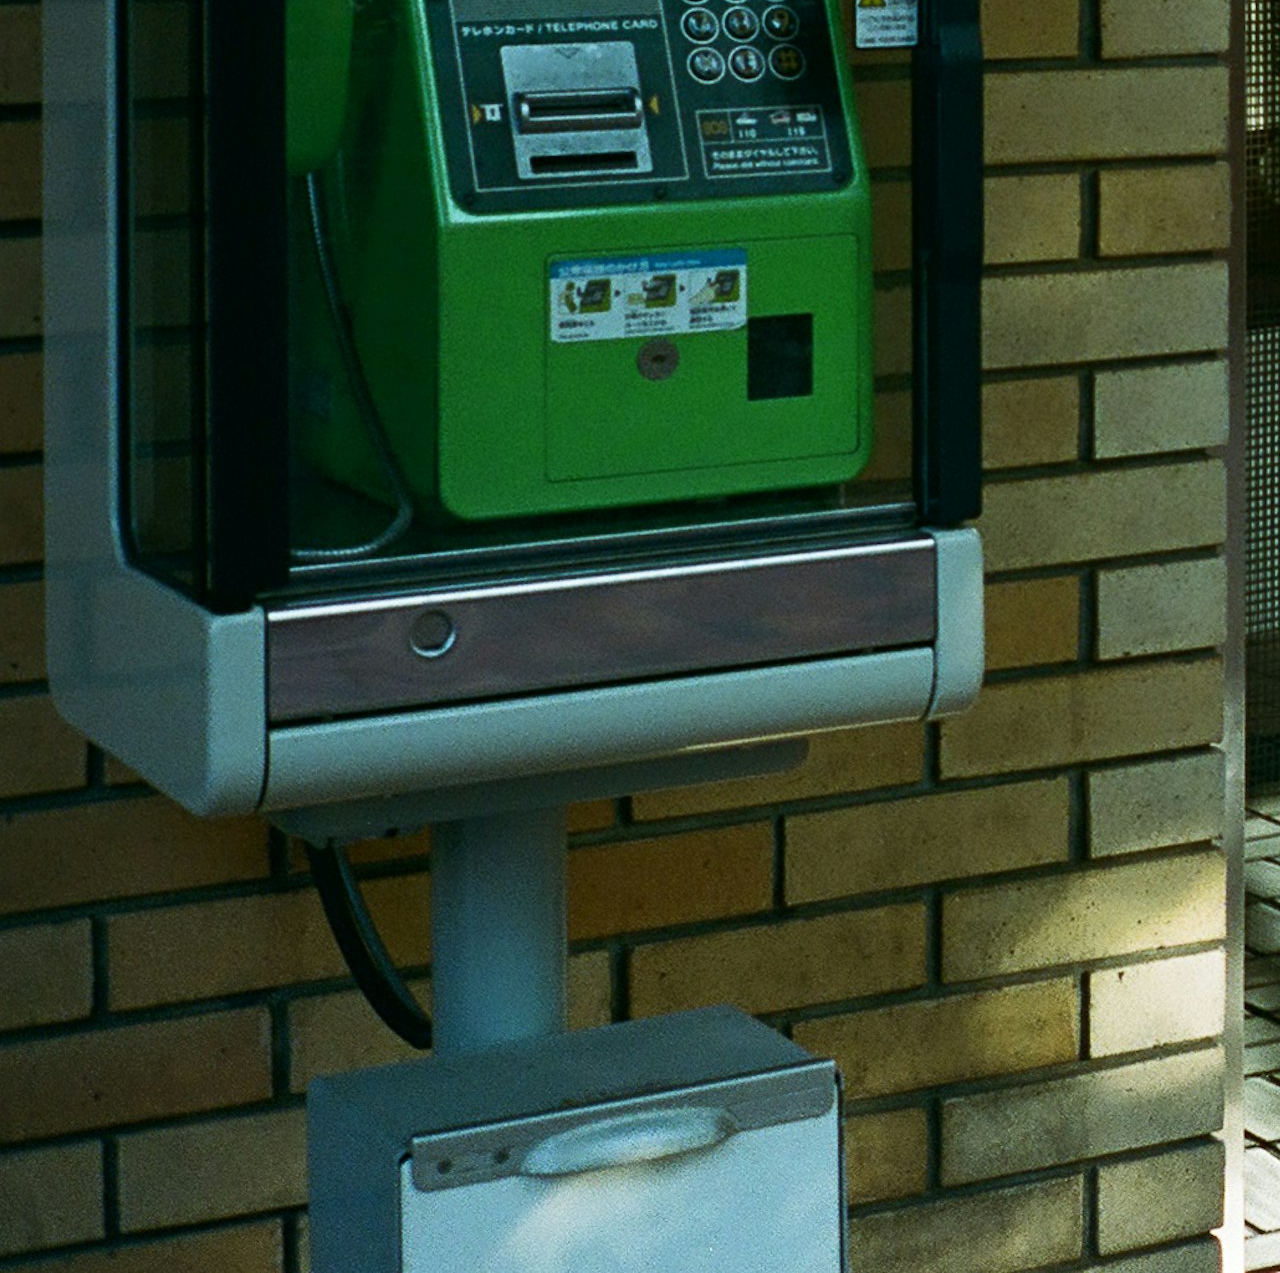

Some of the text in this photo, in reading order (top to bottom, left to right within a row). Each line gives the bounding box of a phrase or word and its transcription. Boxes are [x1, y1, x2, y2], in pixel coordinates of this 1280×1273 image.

[461, 23, 534, 37] テレホンカード
[545, 20, 619, 34] TELEPHONE
[621, 18, 659, 30] CARD
